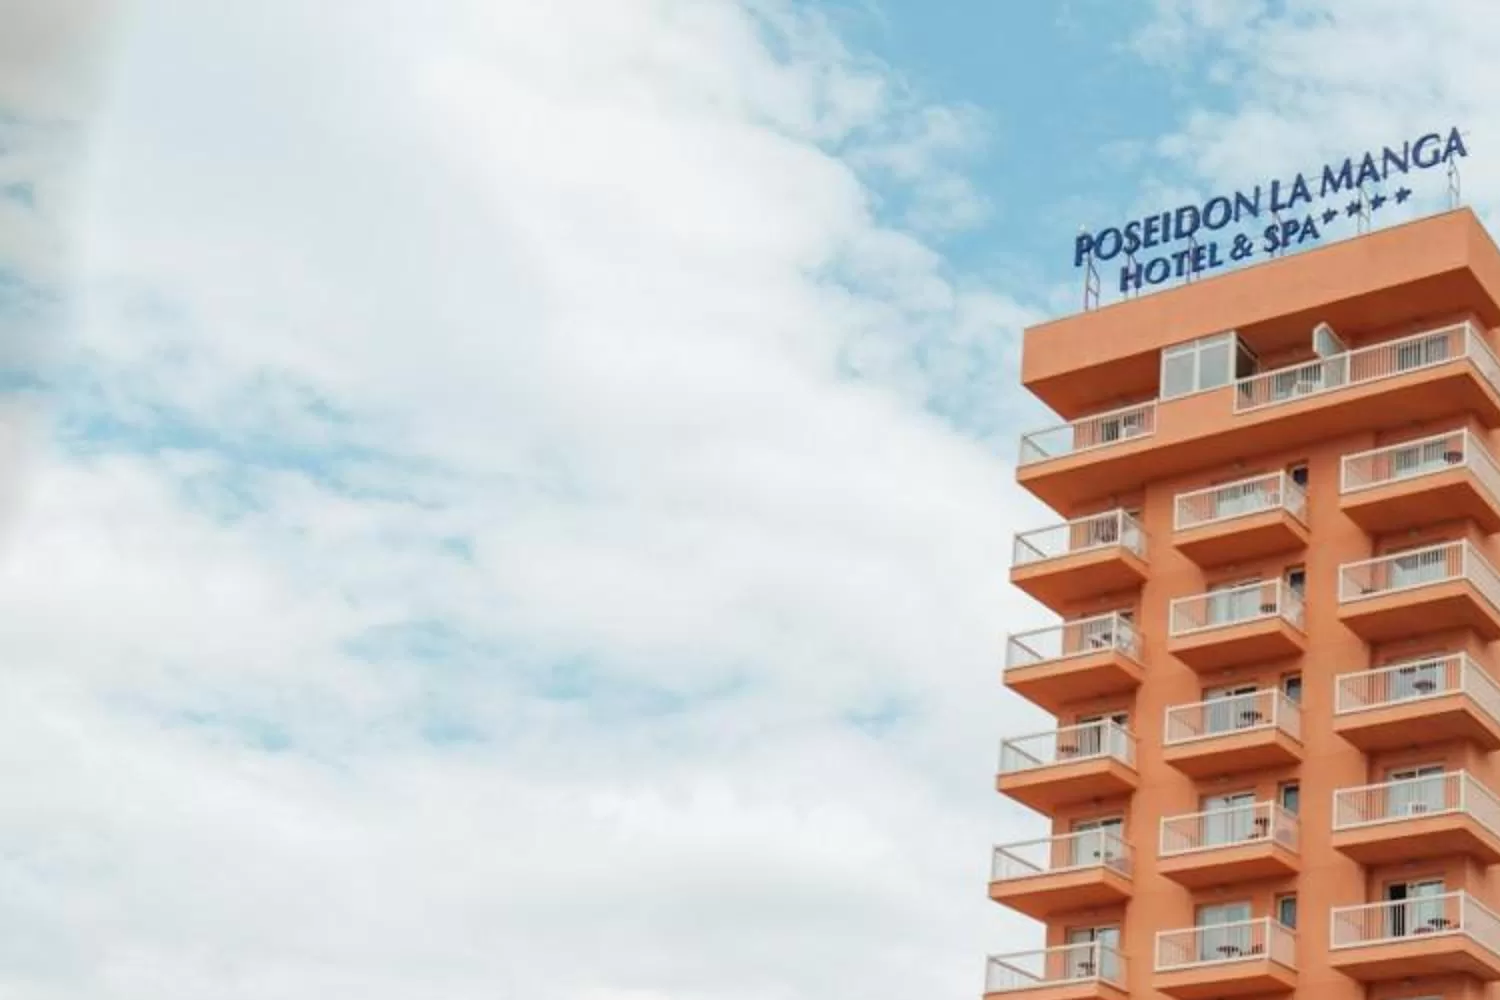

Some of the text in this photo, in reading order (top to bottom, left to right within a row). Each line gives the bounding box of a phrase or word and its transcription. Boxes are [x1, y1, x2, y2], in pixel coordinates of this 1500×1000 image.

[1074, 127, 1468, 267] POSEIDON LA MANGA
[1120, 214, 1320, 292] HOTEL & SPA
